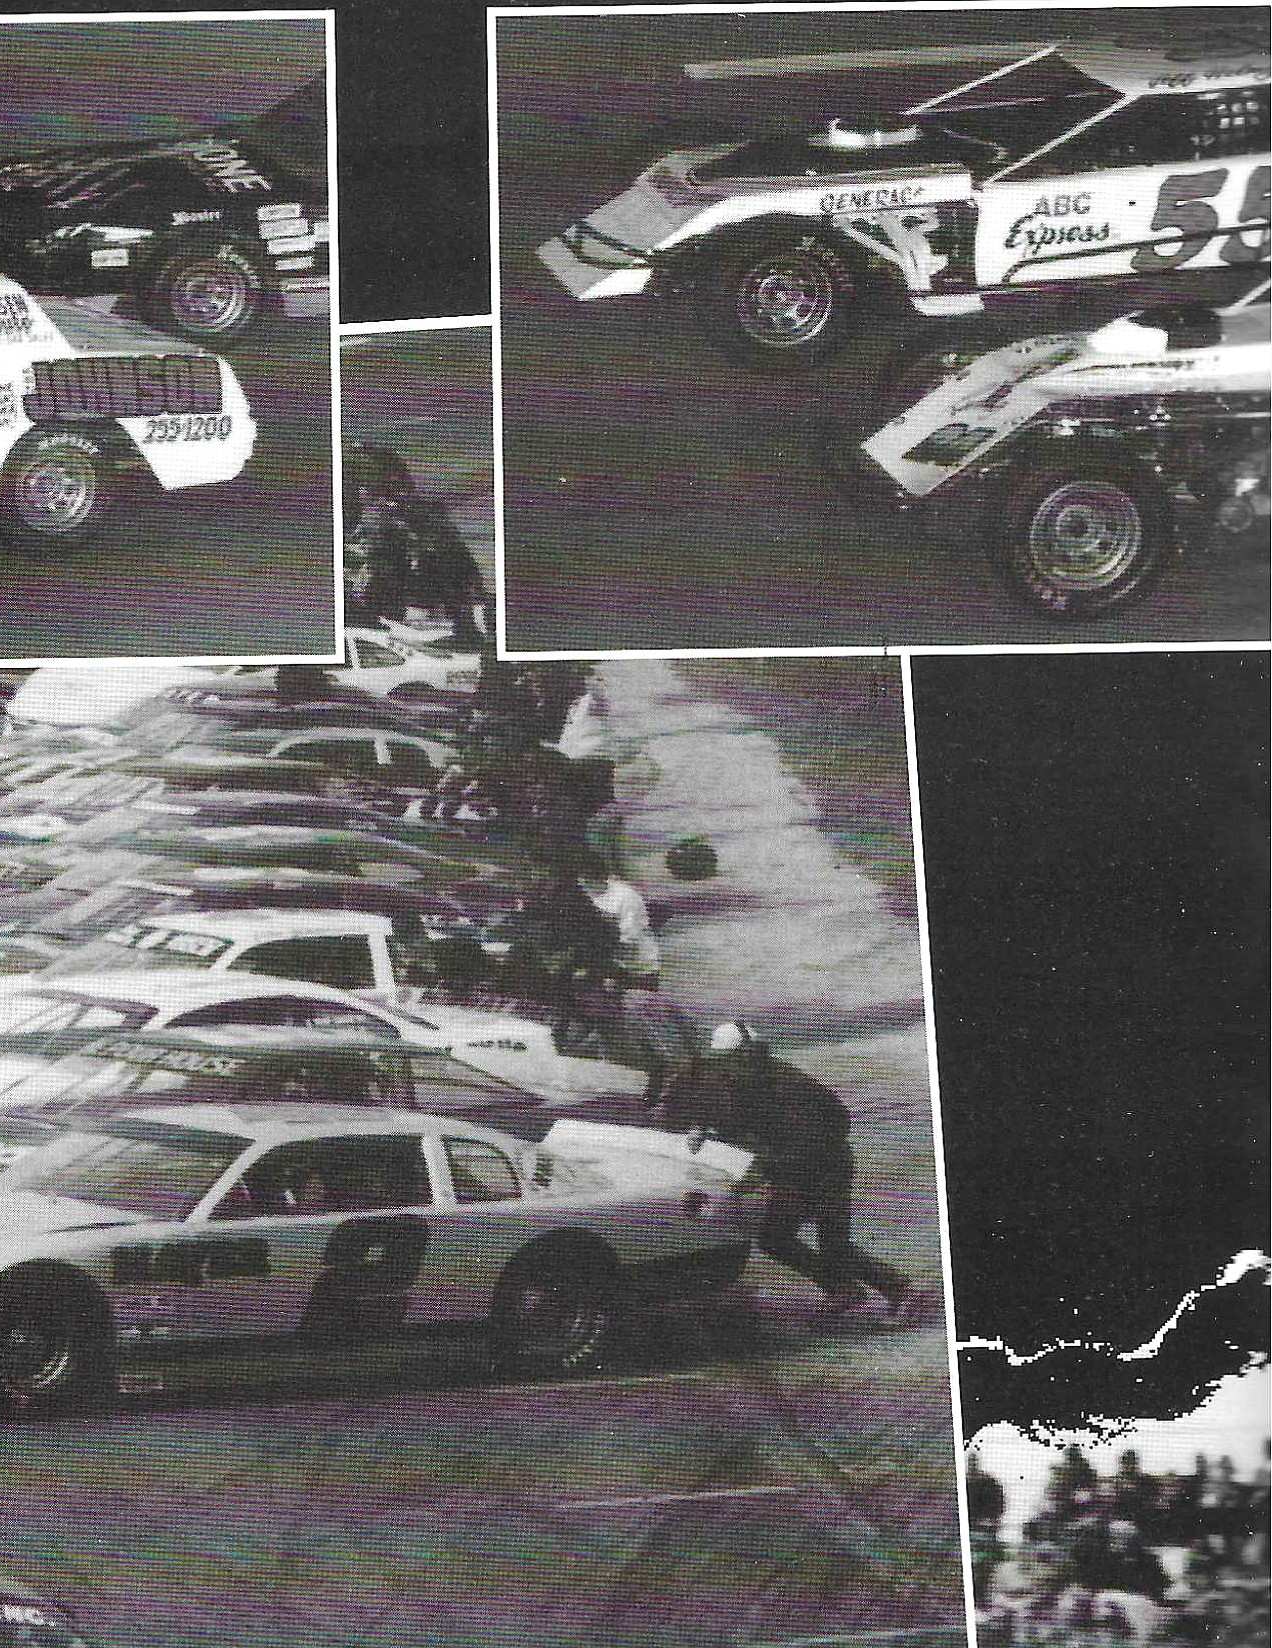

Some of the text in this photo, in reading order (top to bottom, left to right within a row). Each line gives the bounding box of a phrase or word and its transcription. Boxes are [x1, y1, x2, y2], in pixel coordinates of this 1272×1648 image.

[1034, 192, 1092, 216] ABC
[1002, 212, 1112, 254] Express
[21, 356, 224, 420] JOHNSON
